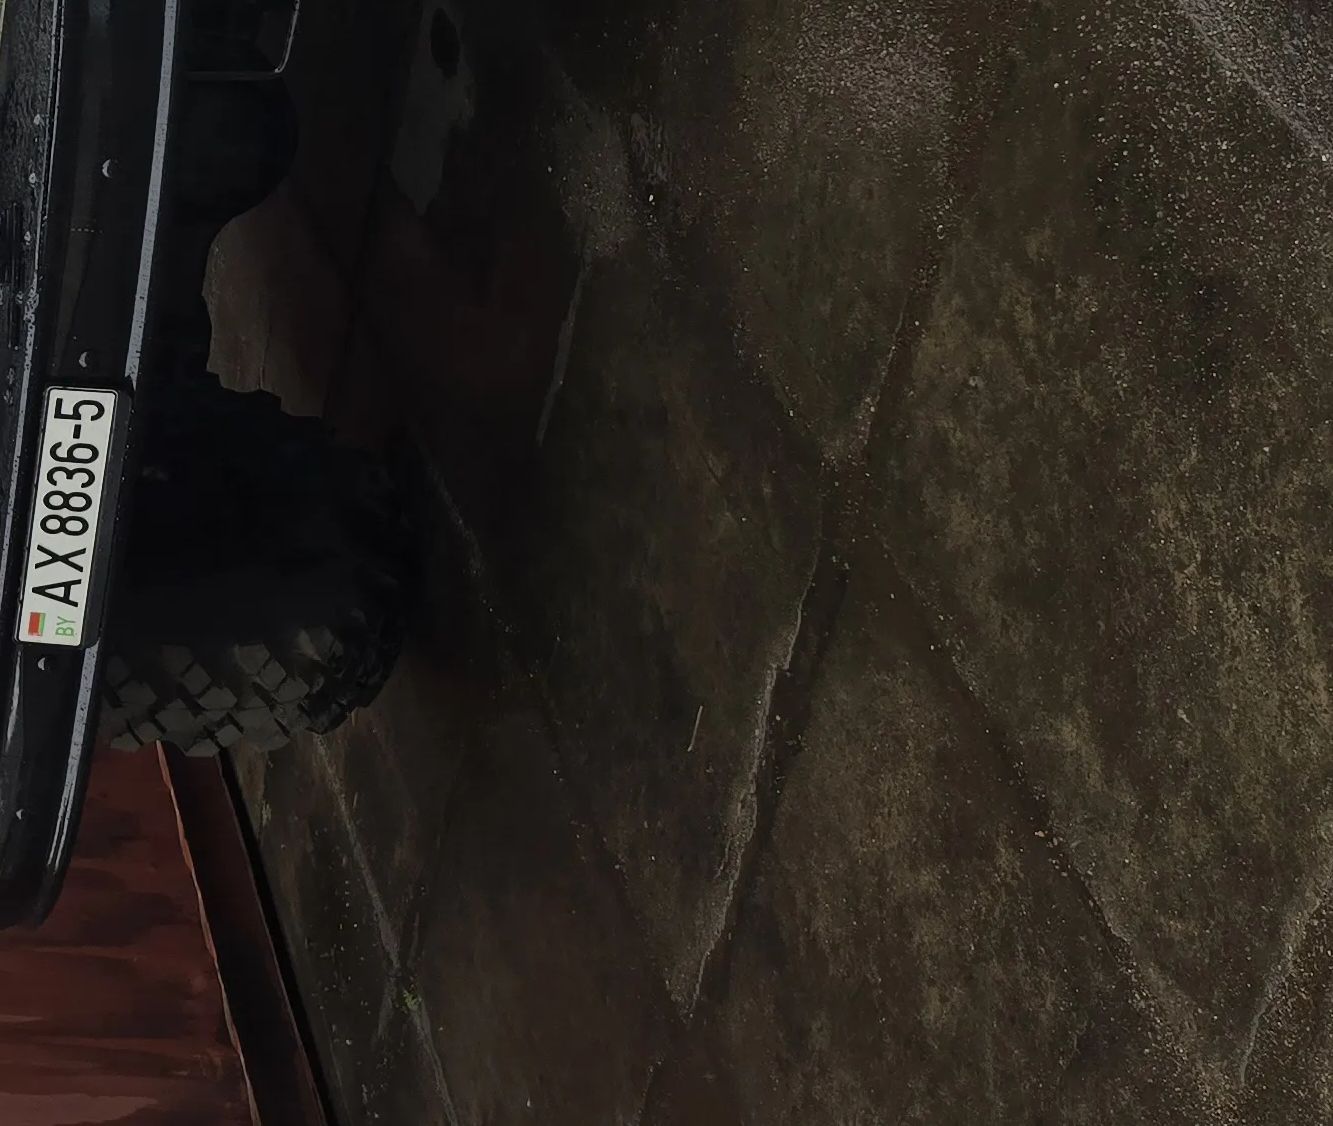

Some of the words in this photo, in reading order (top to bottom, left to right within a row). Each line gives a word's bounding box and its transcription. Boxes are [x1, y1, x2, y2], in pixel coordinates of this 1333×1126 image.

[40, 398, 105, 537] 8836-5
[32, 545, 86, 608] AX
[55, 615, 76, 637] BY
